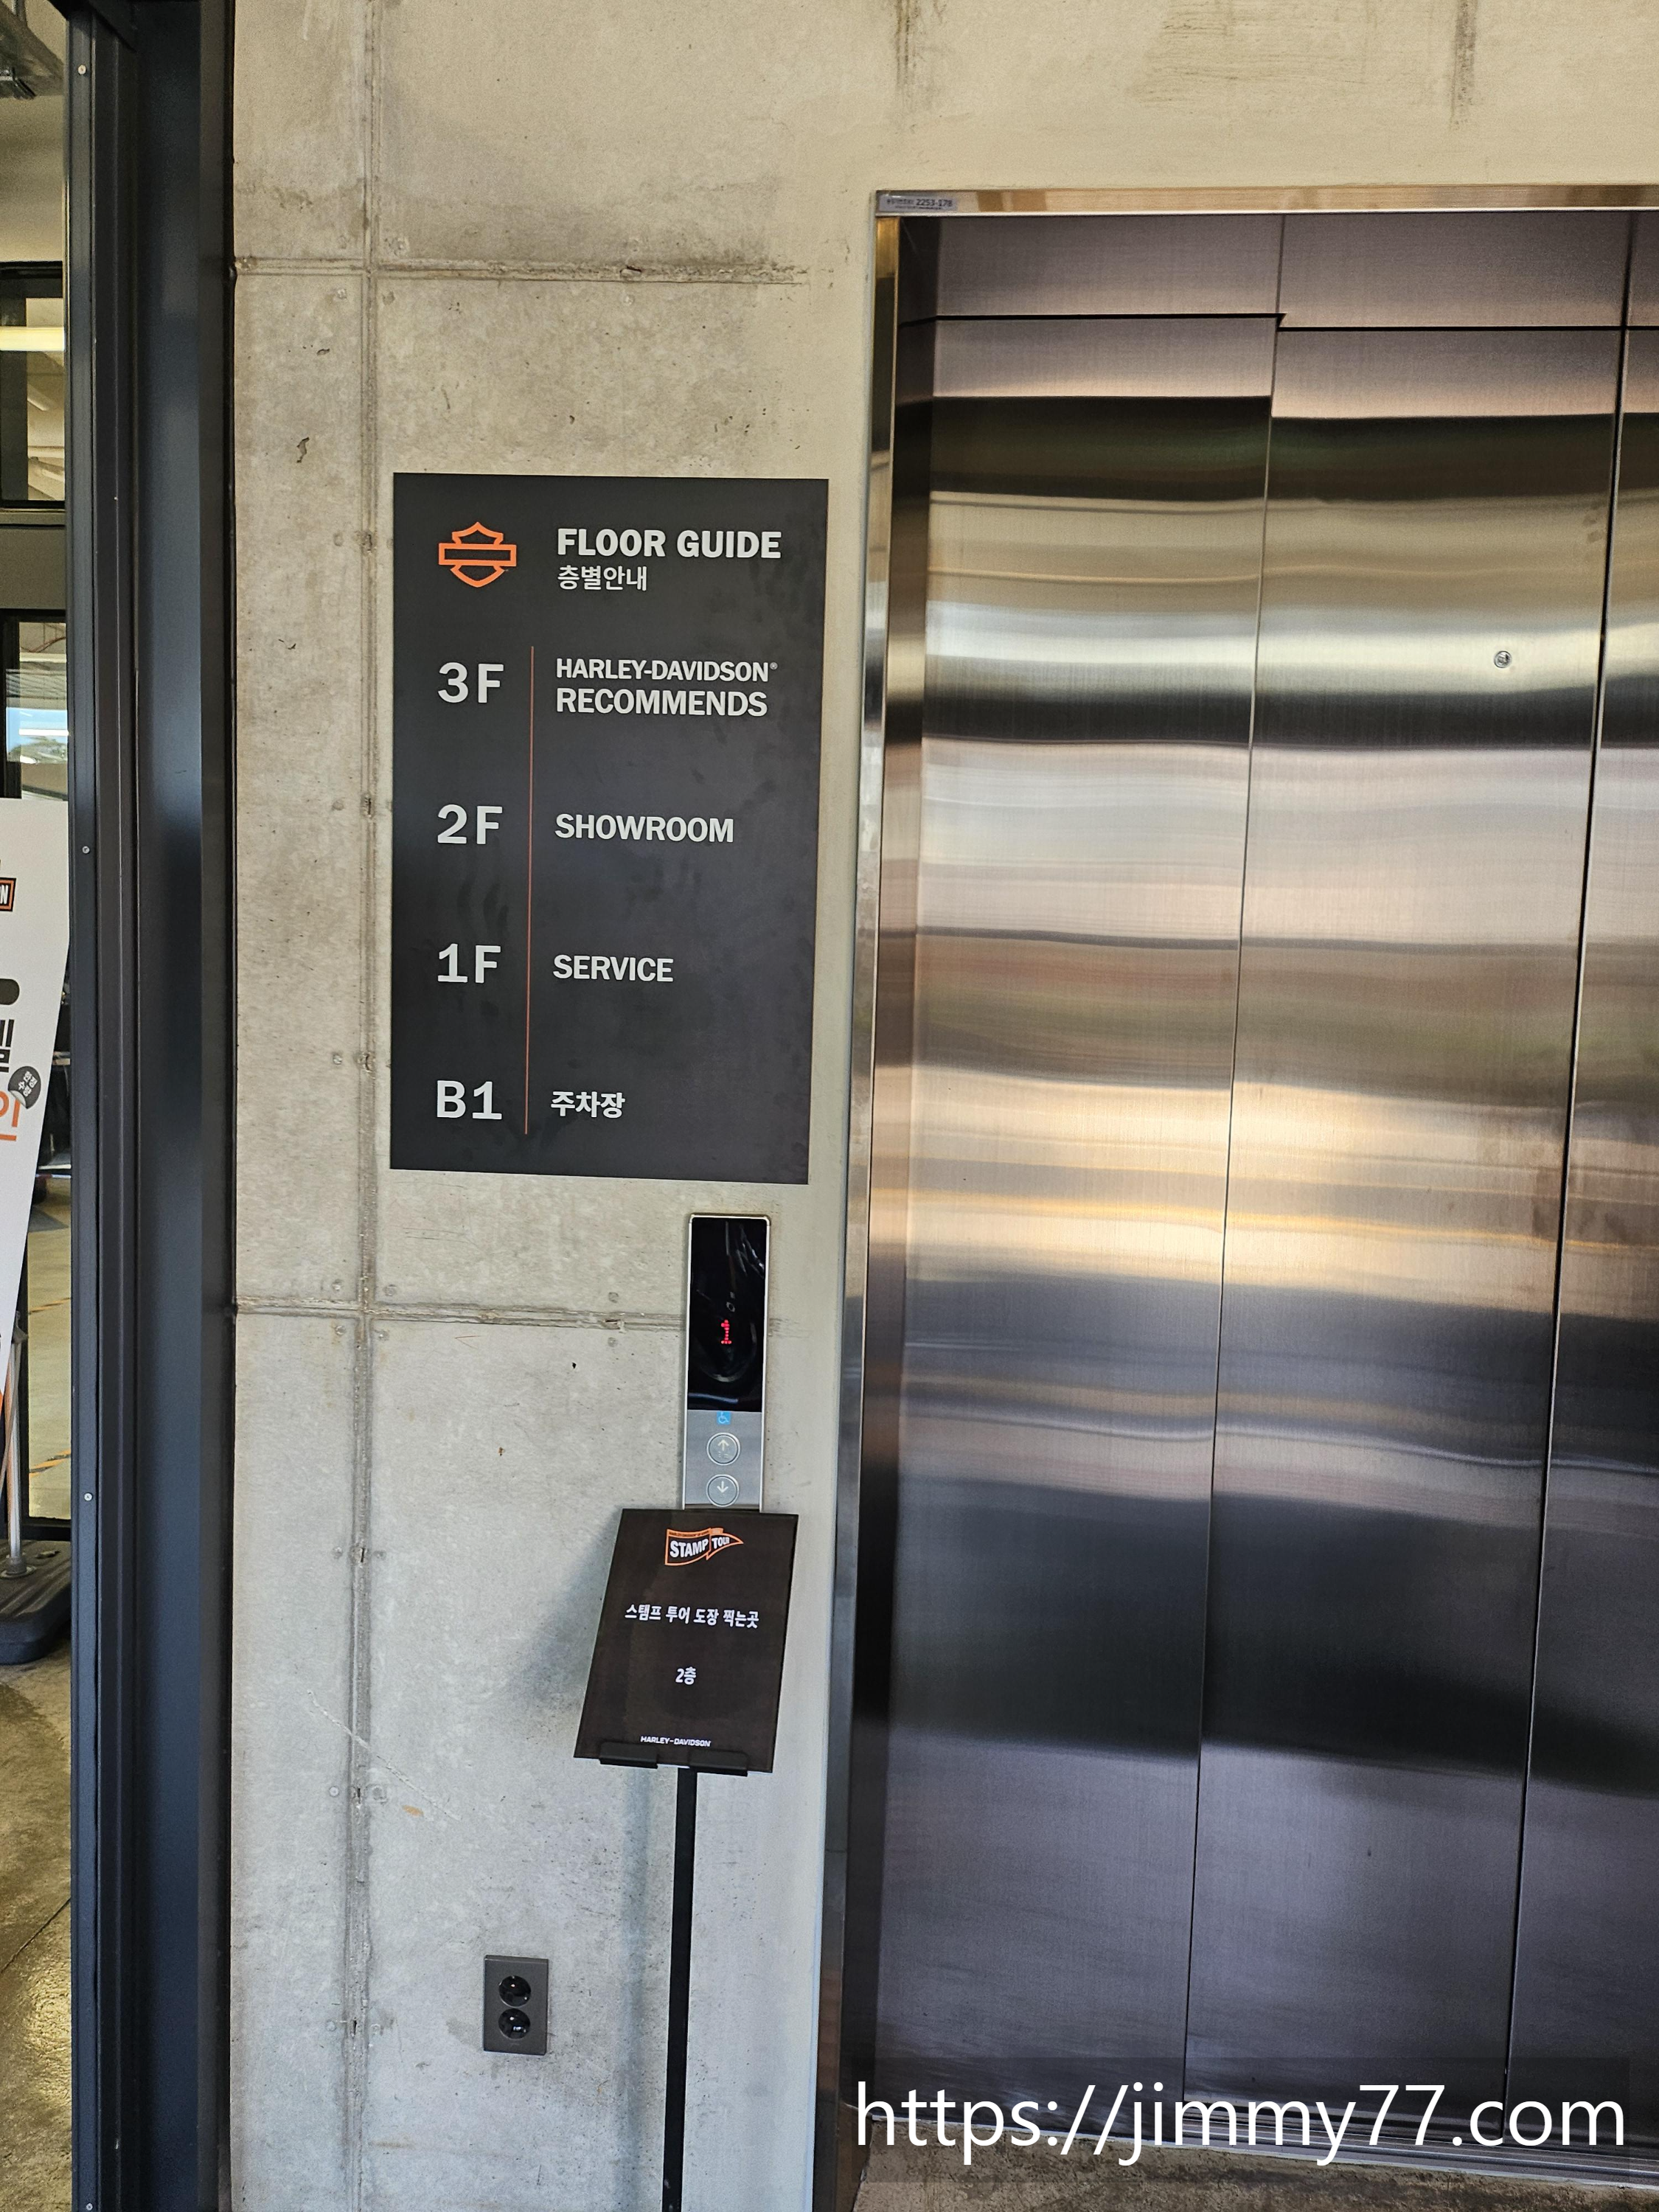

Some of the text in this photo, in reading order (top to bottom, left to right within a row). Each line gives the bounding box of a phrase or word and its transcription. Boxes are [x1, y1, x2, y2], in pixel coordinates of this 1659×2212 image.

[558, 529, 782, 559] FLOOR GUIDE
[557, 566, 647, 591] 층별안내
[438, 663, 504, 703] 3F
[557, 688, 768, 717] RECOMMENDS
[437, 804, 503, 845] 2F
[554, 814, 734, 843] SHOWROOM
[437, 944, 501, 984] 1F
[553, 955, 674, 982] SERVICE
[437, 1080, 502, 1120] B1
[551, 1091, 626, 1119] 주차장
[720, 1319, 732, 1345] 1
[669, 1538, 709, 1557] STAMP
[625, 1604, 759, 1629] 스탬프 투어 도장 찍는곳
[675, 1666, 697, 1686] 2층
[640, 1736, 712, 1747] HARLEY-DAVIDSON
